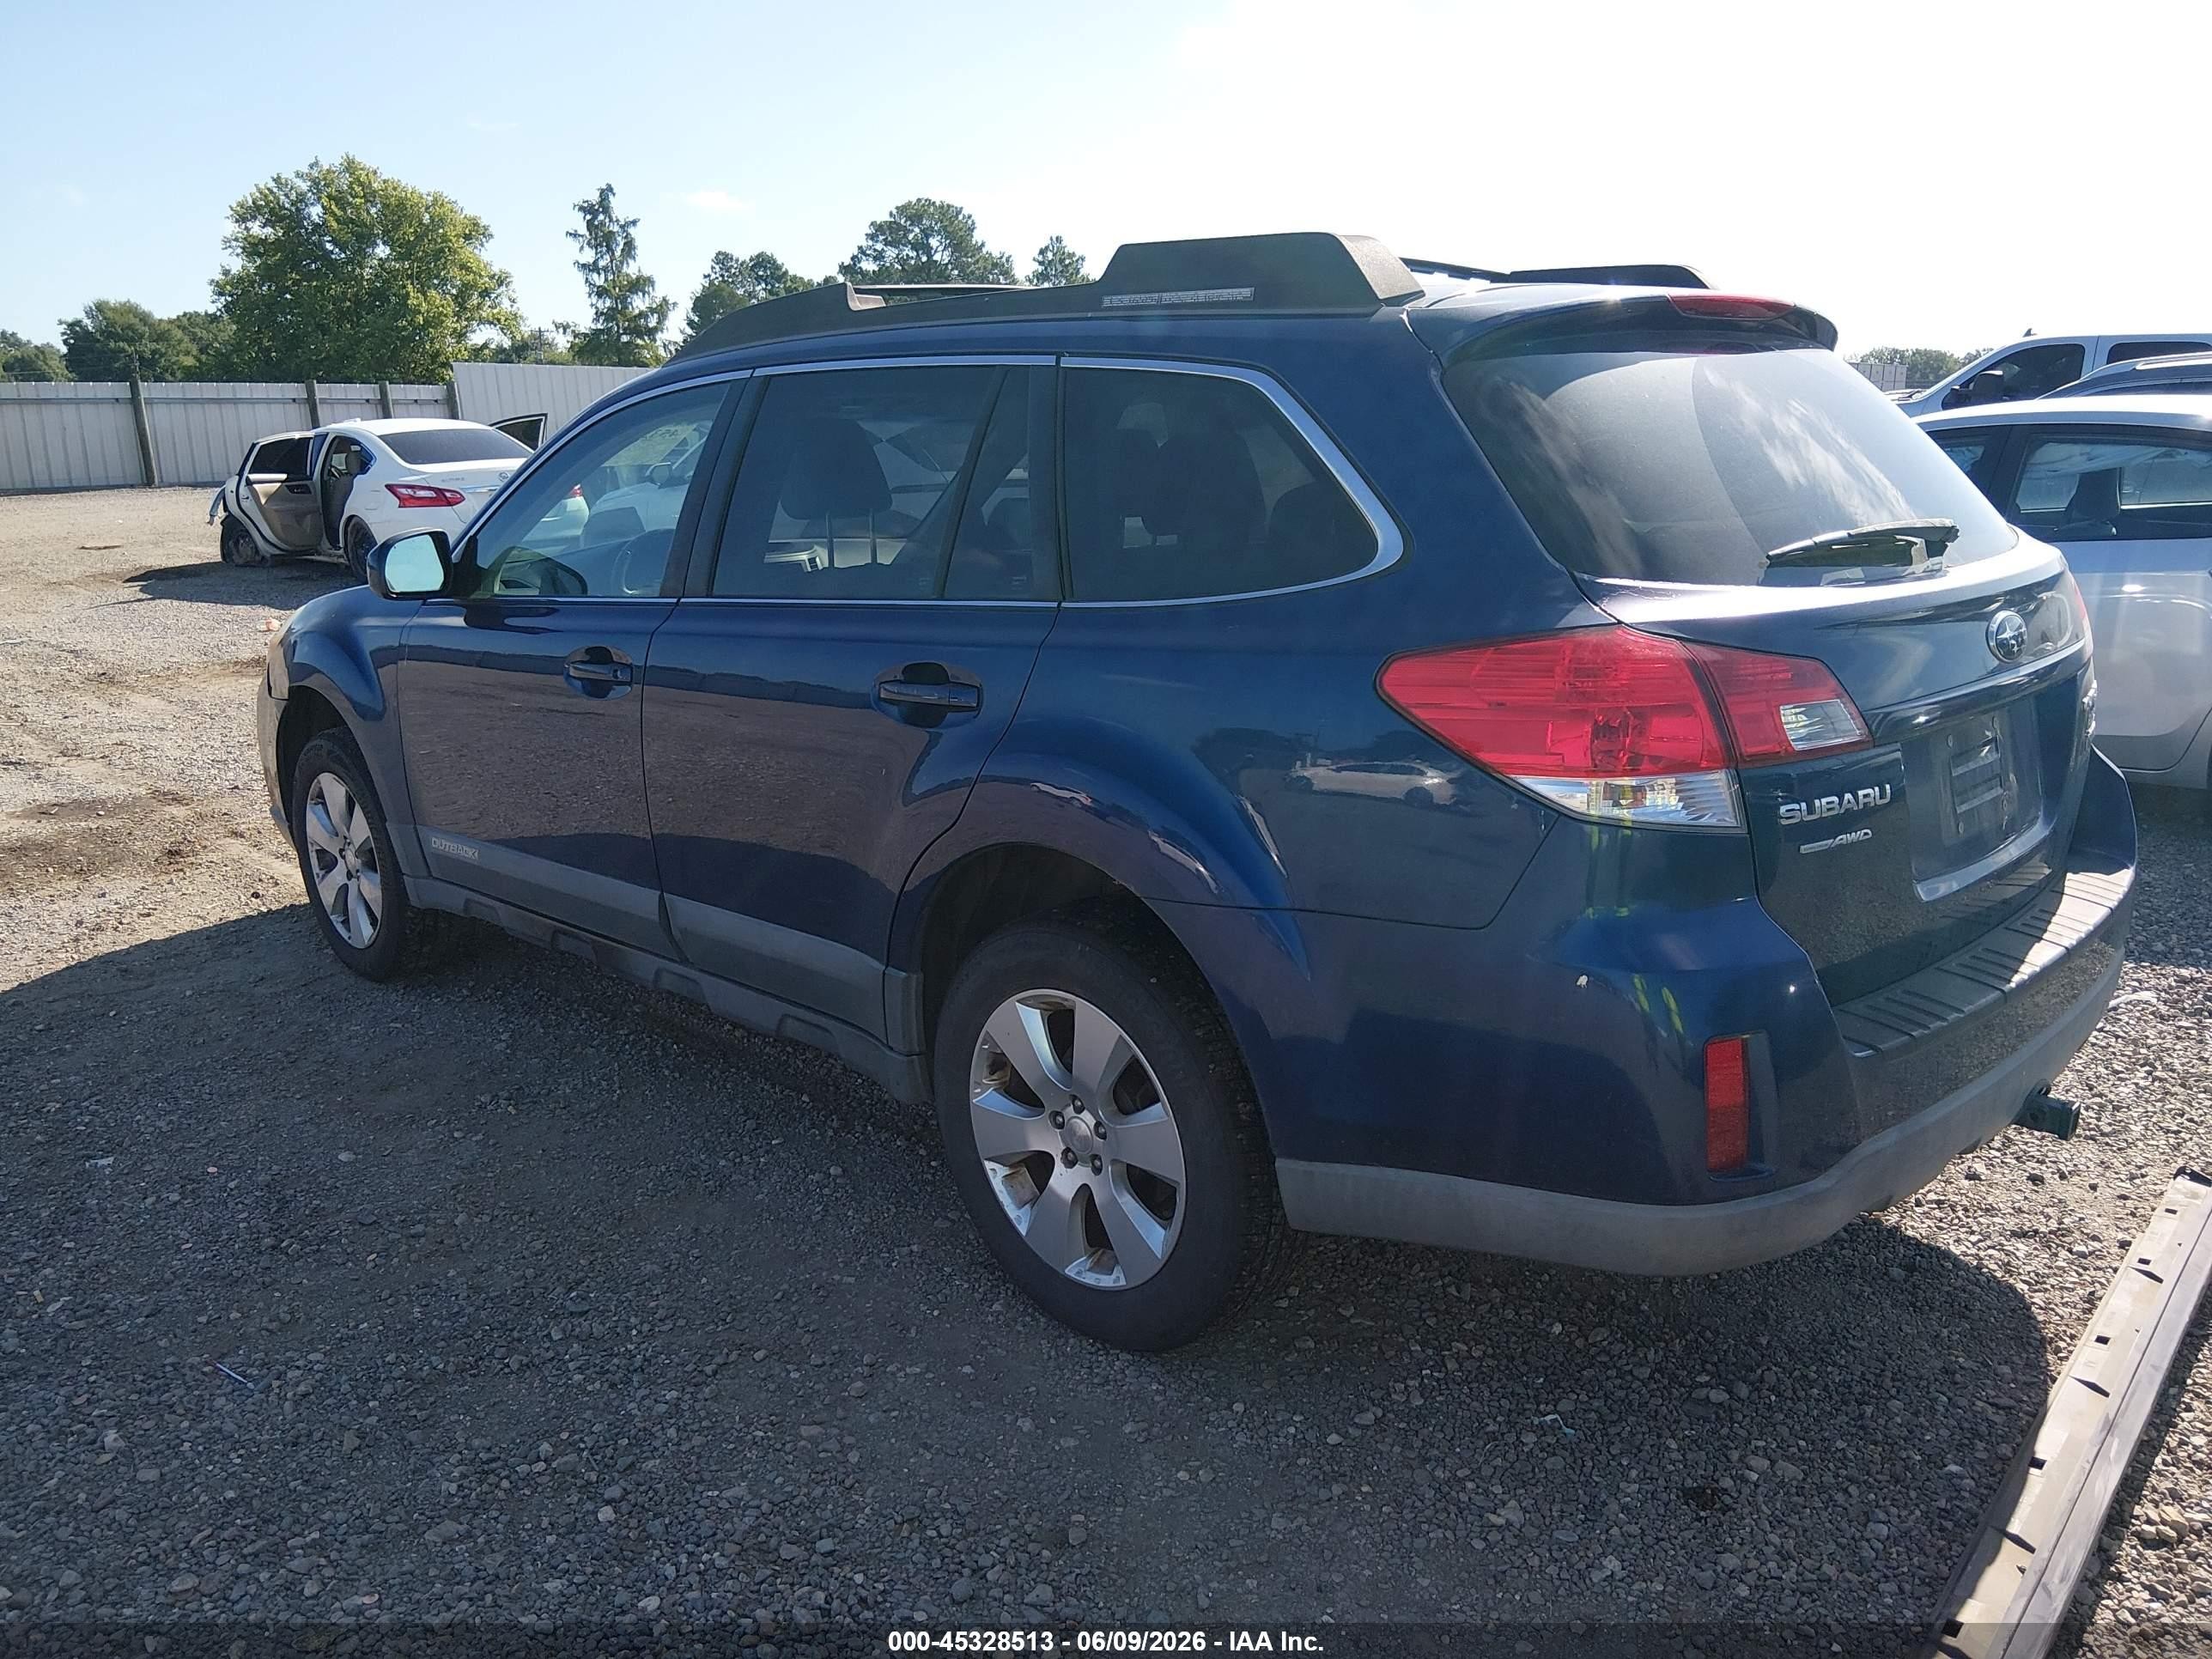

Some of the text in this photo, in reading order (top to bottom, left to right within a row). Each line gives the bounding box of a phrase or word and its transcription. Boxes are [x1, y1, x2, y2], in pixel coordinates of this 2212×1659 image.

[1778, 783, 1892, 825] SUBARU
[431, 836, 480, 860] OUTBACK
[1831, 829, 1873, 848] AWD
